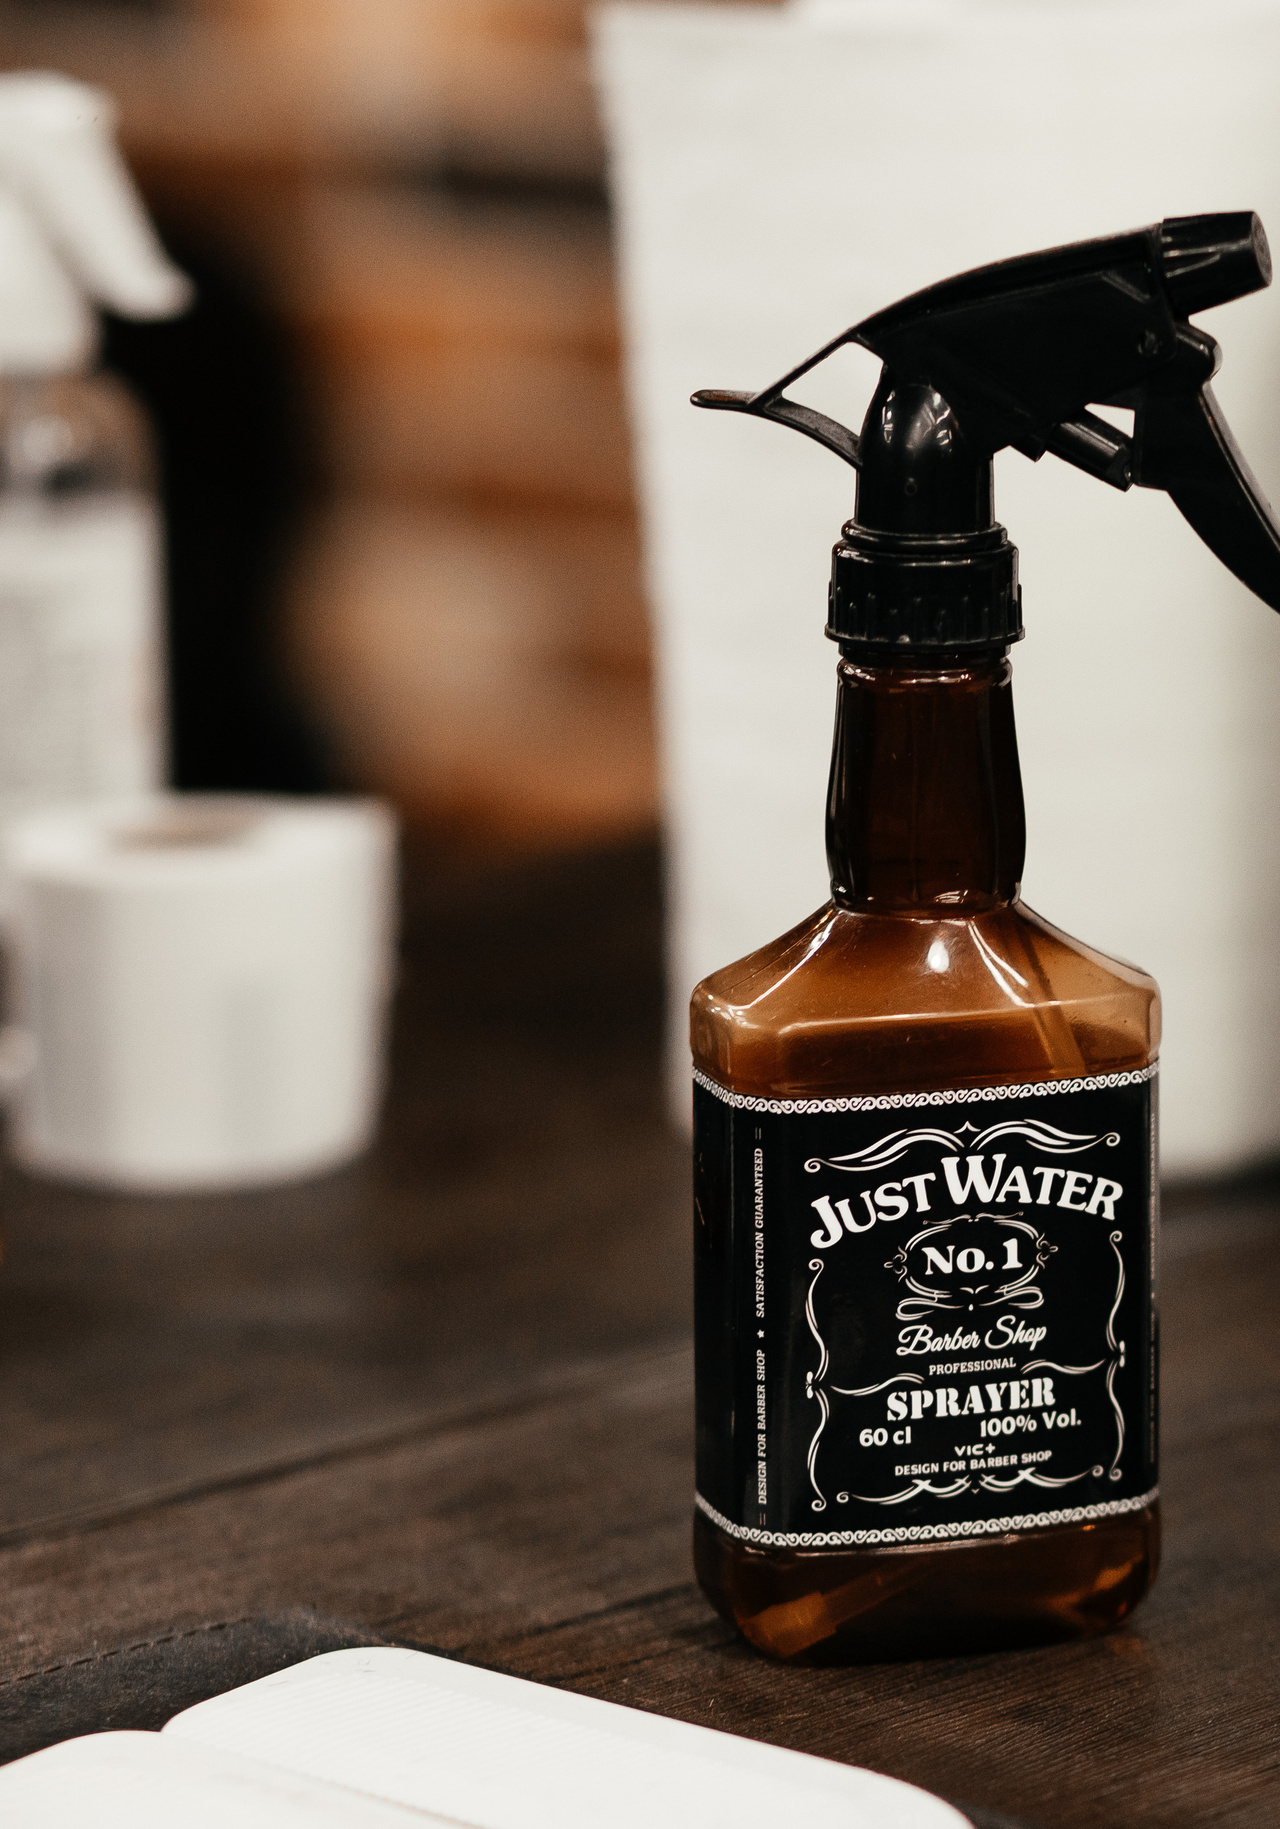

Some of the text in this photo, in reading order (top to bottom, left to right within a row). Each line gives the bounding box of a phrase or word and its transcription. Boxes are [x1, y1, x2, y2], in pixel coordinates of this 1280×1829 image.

[810, 1153, 1123, 1249] JUST WATER
[754, 1148, 765, 1319] SATISFACTION GUARANTEED
[921, 1237, 1023, 1275] No. 1
[896, 1314, 1047, 1356] Barber Shop
[929, 1356, 1016, 1376] PROFESSIONAL
[887, 1377, 1056, 1421] SPRAYER
[756, 1349, 767, 1505] DESIGN FOR BARBER SHOP
[859, 1426, 912, 1447] 60 cl
[980, 1408, 1081, 1438] 100% Vol.
[895, 1450, 1052, 1476] DESIGN FOR BARBER SHOP
